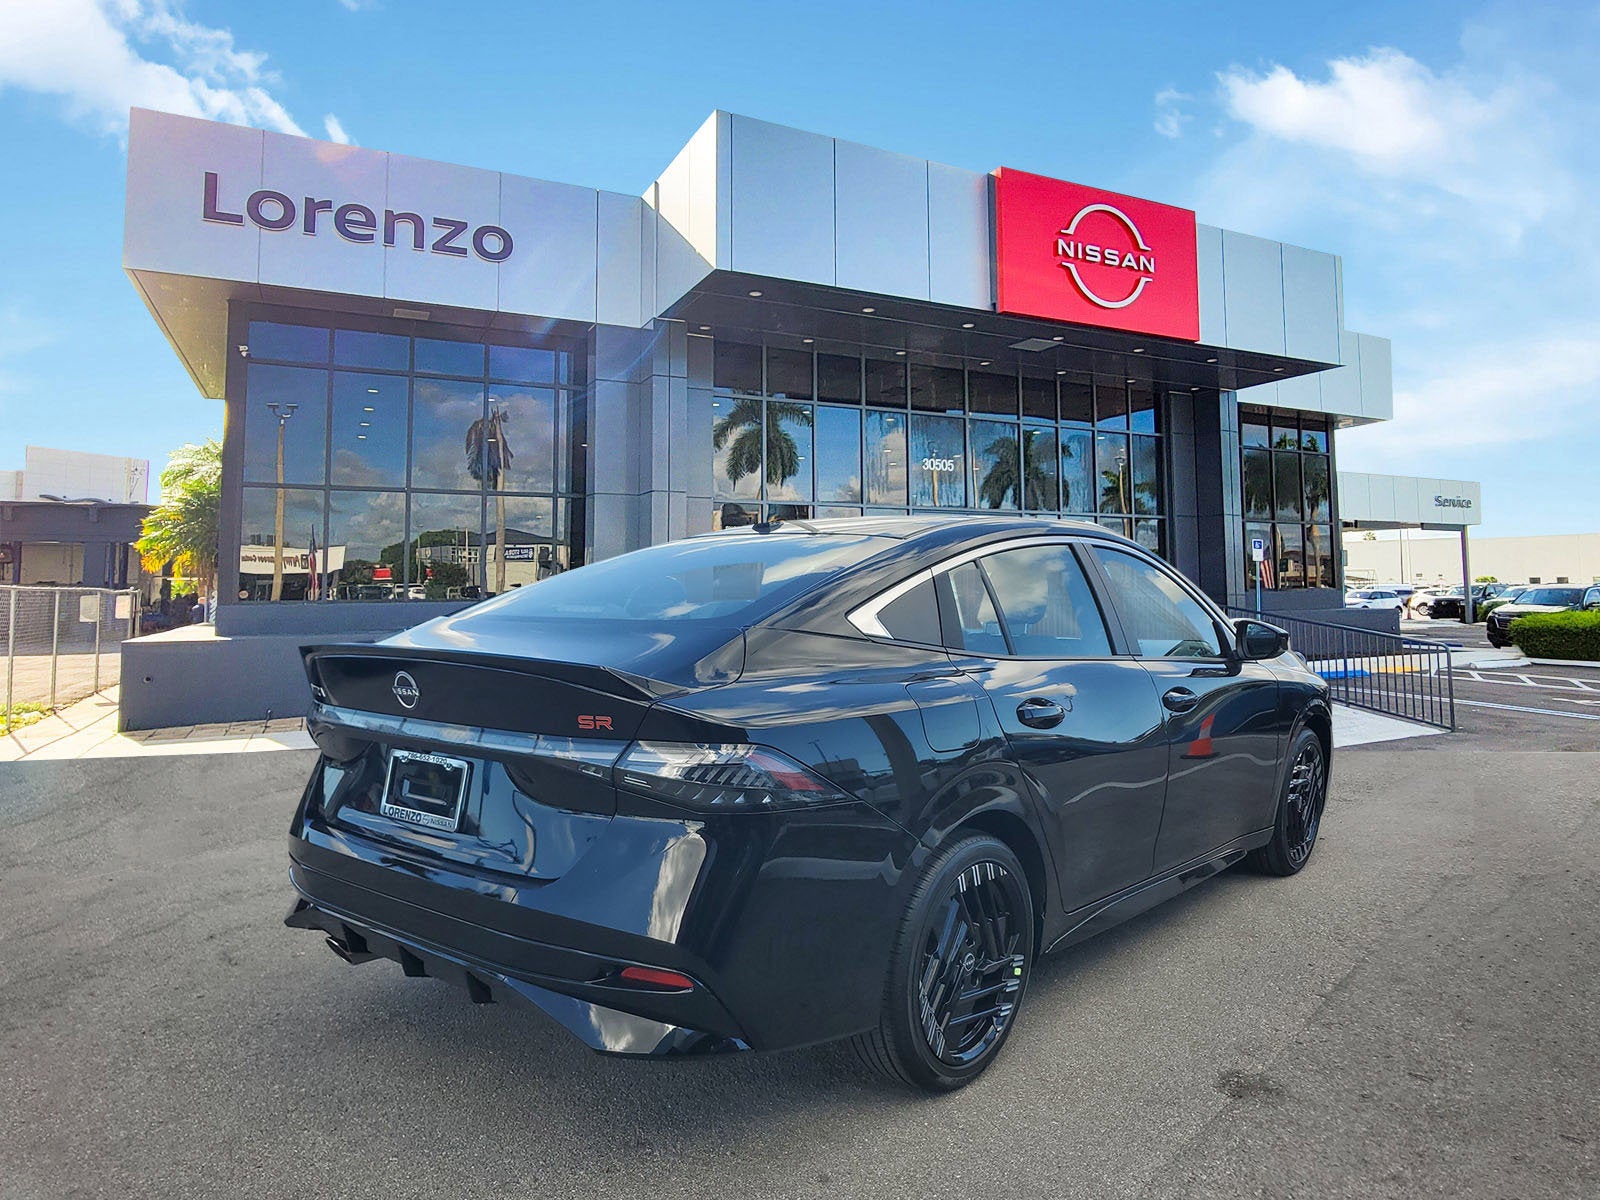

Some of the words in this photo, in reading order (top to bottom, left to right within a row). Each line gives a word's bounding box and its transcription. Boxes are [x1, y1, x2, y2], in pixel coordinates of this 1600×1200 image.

[203, 171, 514, 262] Lorenzo
[1057, 238, 1155, 273] NISSAN
[922, 458, 954, 471] 30505
[1434, 495, 1472, 508] Service
[577, 715, 614, 730] SR
[384, 805, 422, 823] LORENZO
